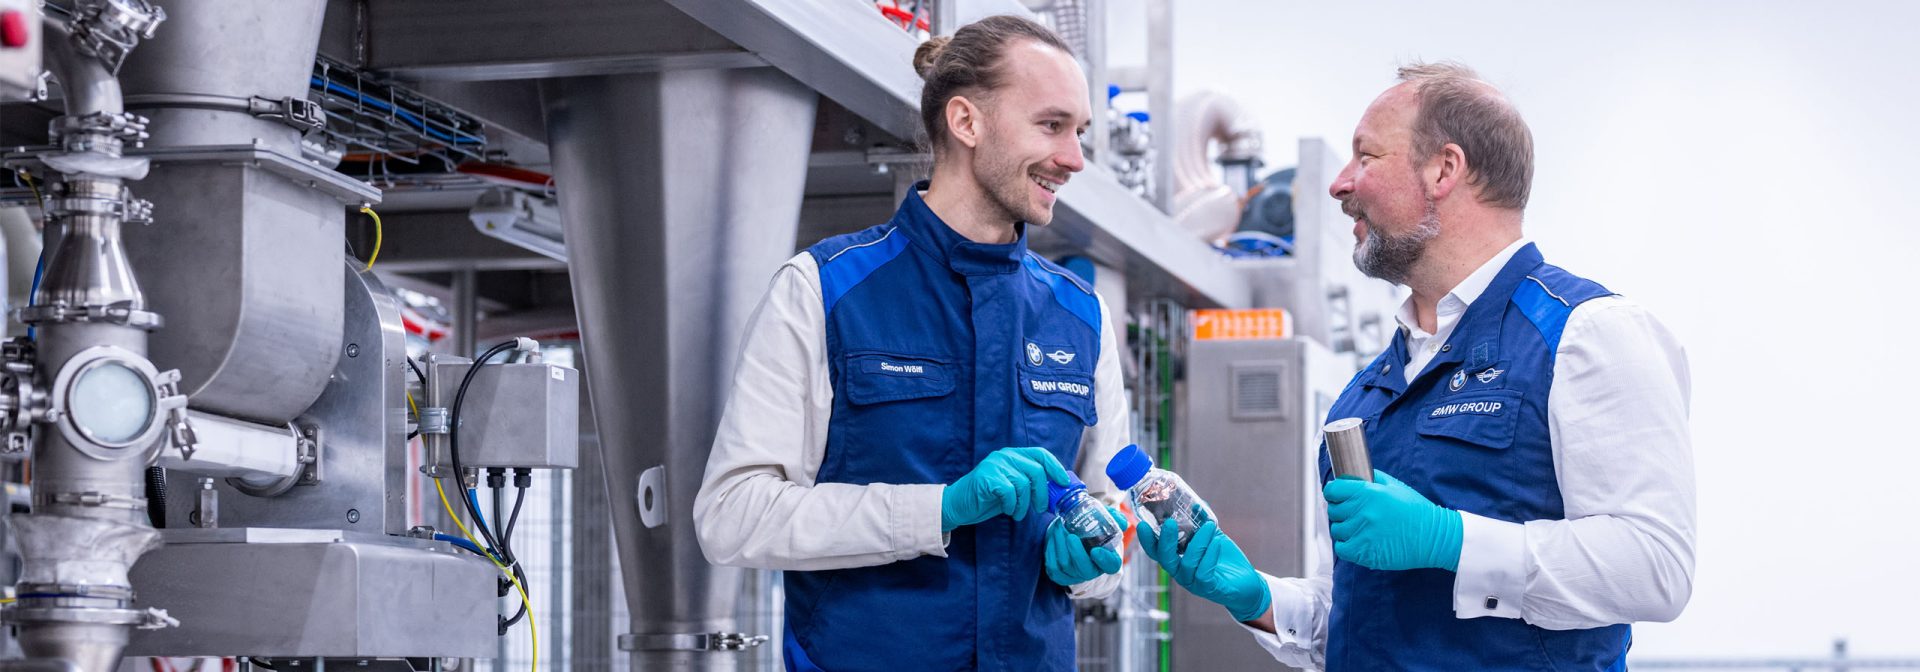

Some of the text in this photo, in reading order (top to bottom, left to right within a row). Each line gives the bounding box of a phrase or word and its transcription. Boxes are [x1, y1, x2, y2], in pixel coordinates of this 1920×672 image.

[880, 362, 903, 372] Simon
[1031, 380, 1089, 395] BMW GROUP
[1431, 402, 1501, 416] BMW GROUP
